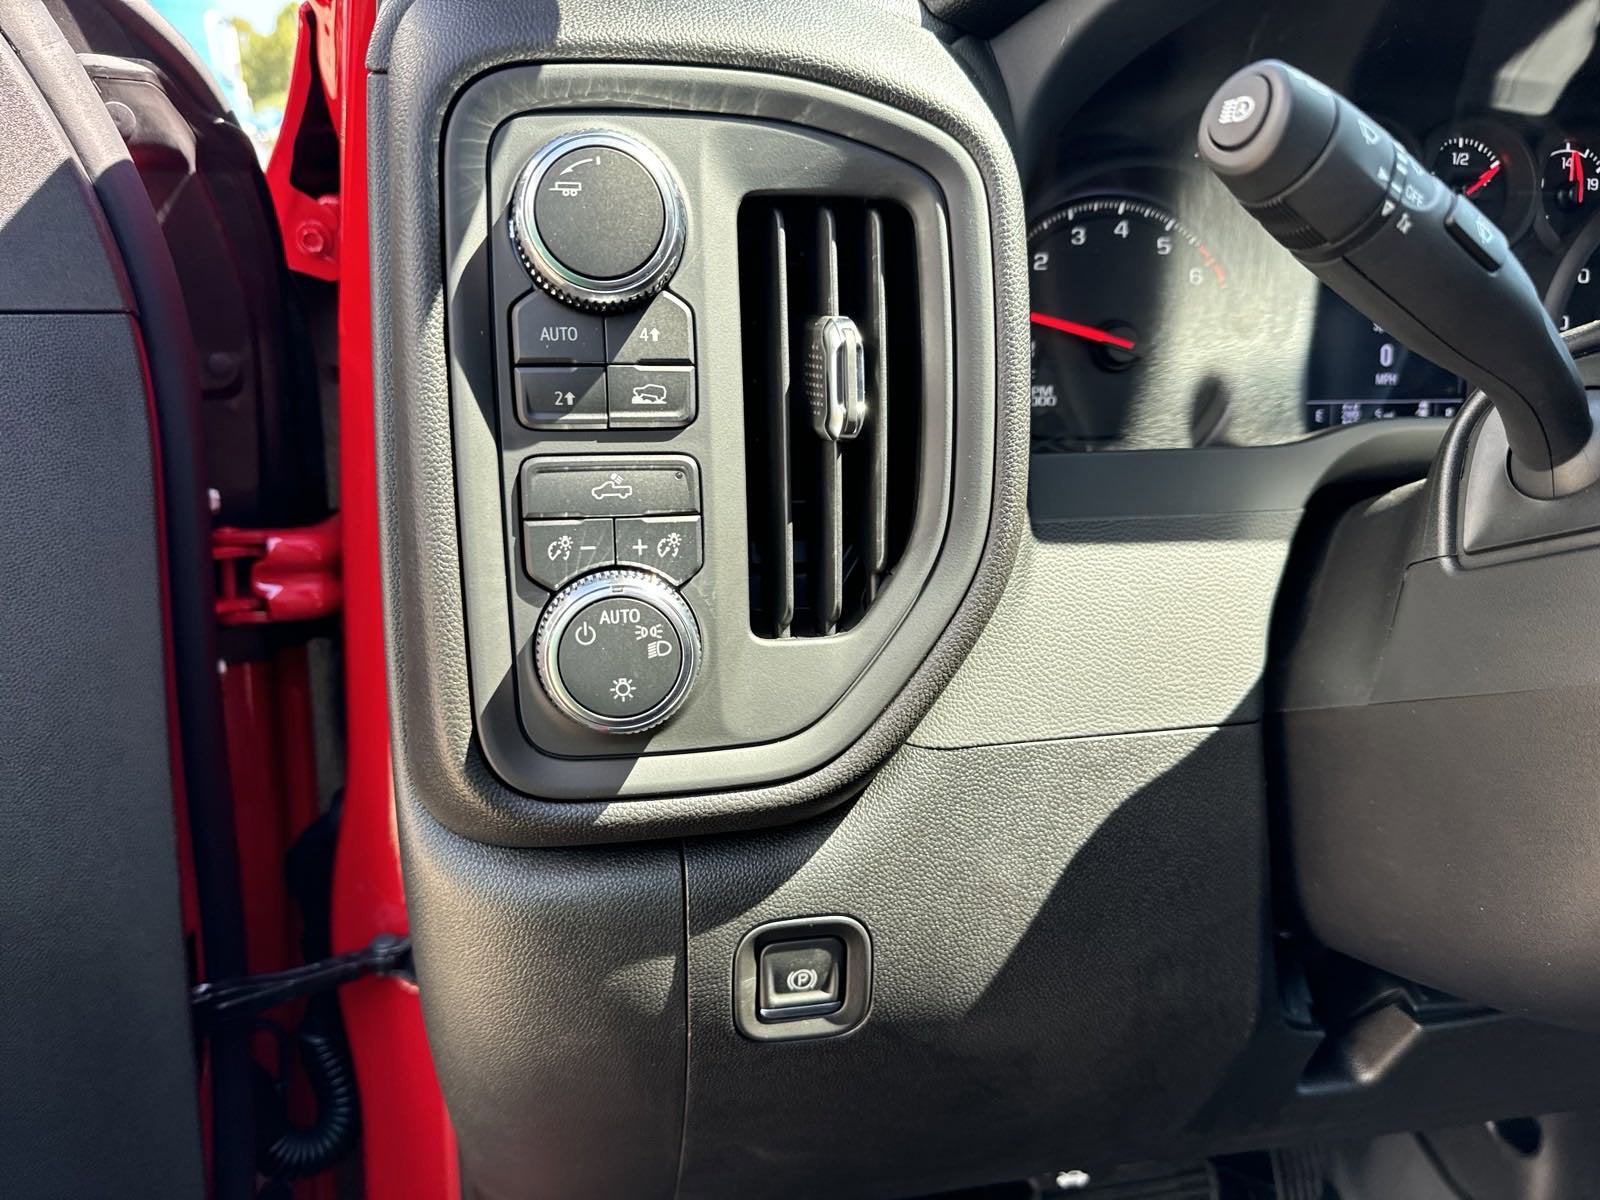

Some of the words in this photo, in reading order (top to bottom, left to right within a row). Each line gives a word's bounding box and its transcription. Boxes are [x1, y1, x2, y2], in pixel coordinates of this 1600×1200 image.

[1452, 152, 1469, 166] 1/2
[1587, 178, 1599, 191] 19
[1405, 184, 1424, 207] OFF
[1071, 227, 1086, 245] 3
[1114, 220, 1129, 239] 4
[1156, 237, 1172, 255] 5
[1033, 252, 1049, 271] 2
[1189, 268, 1203, 285] 6
[540, 327, 578, 341] AUTO
[639, 328, 649, 342] 4
[1380, 343, 1393, 367] 0
[1375, 373, 1397, 385] MPH
[554, 391, 564, 406] 2
[1031, 385, 1054, 397] PM
[599, 608, 641, 625] AUTO
